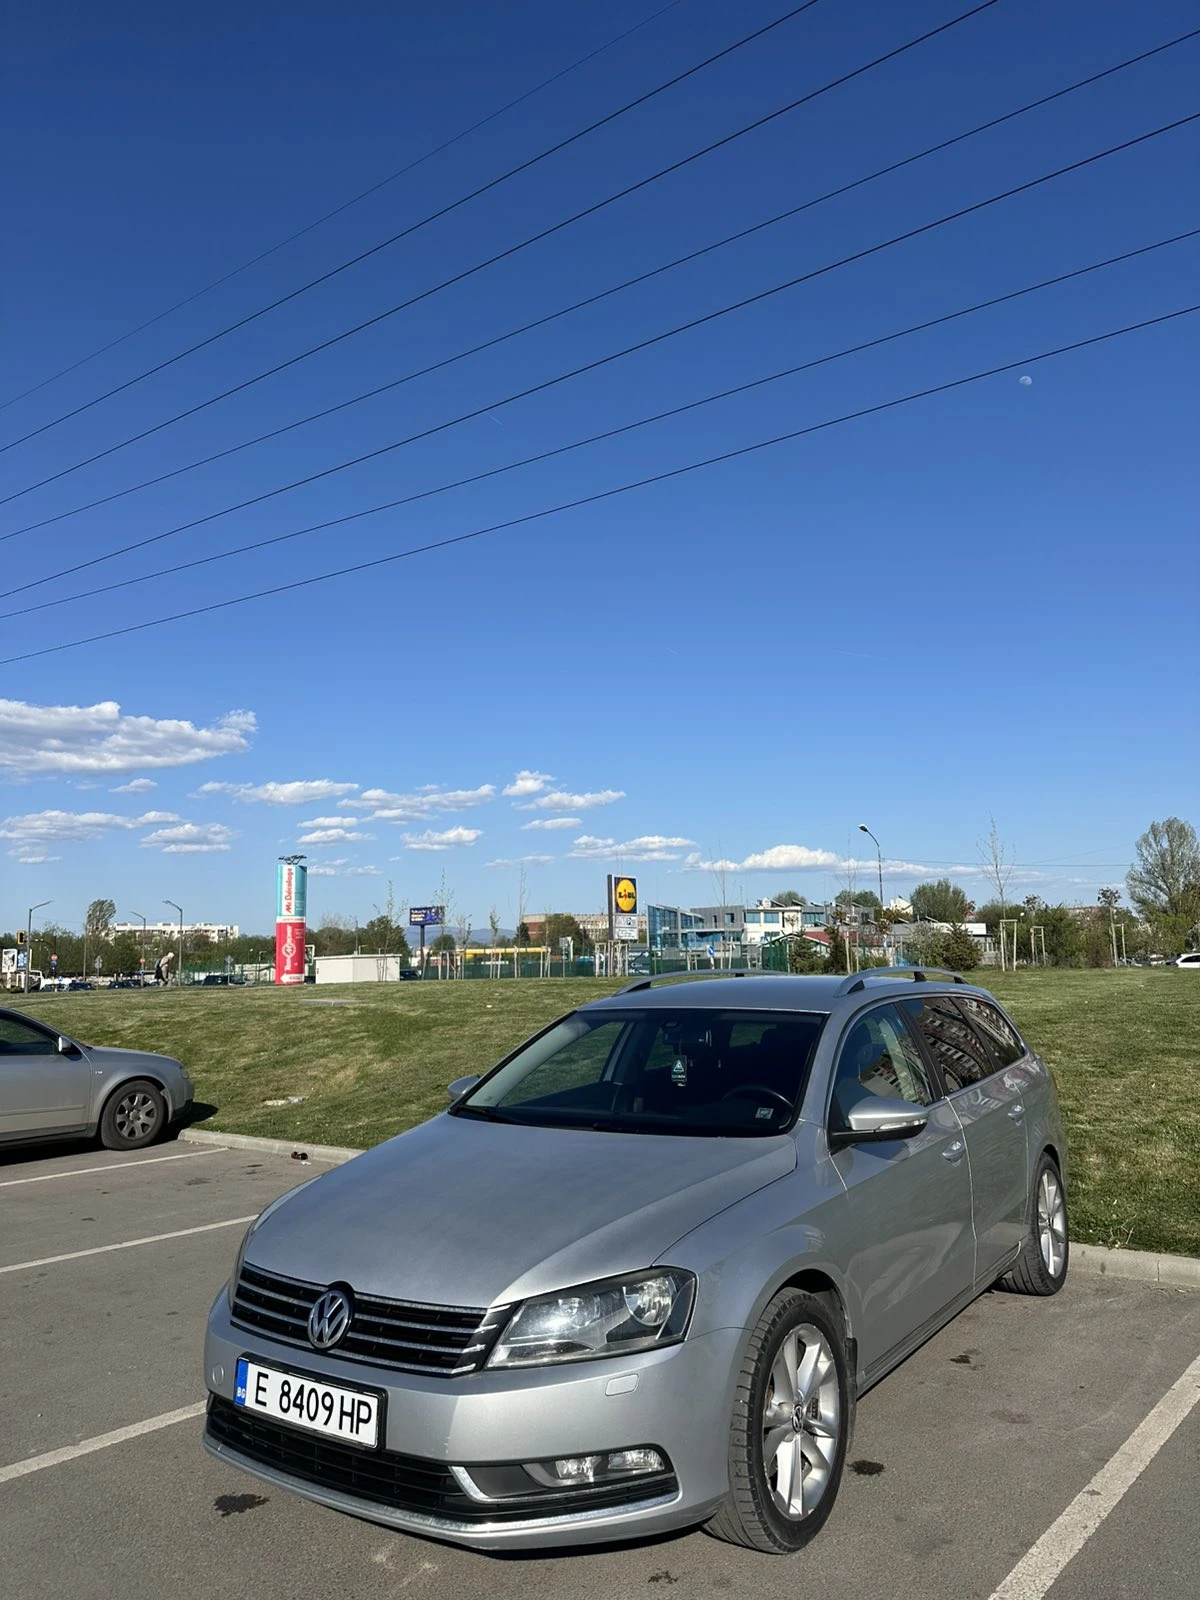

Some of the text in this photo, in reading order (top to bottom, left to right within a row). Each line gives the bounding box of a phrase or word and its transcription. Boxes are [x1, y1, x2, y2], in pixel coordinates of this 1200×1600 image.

[236, 1386, 246, 1399] BG
[255, 1371, 372, 1435] E 8409 HP
